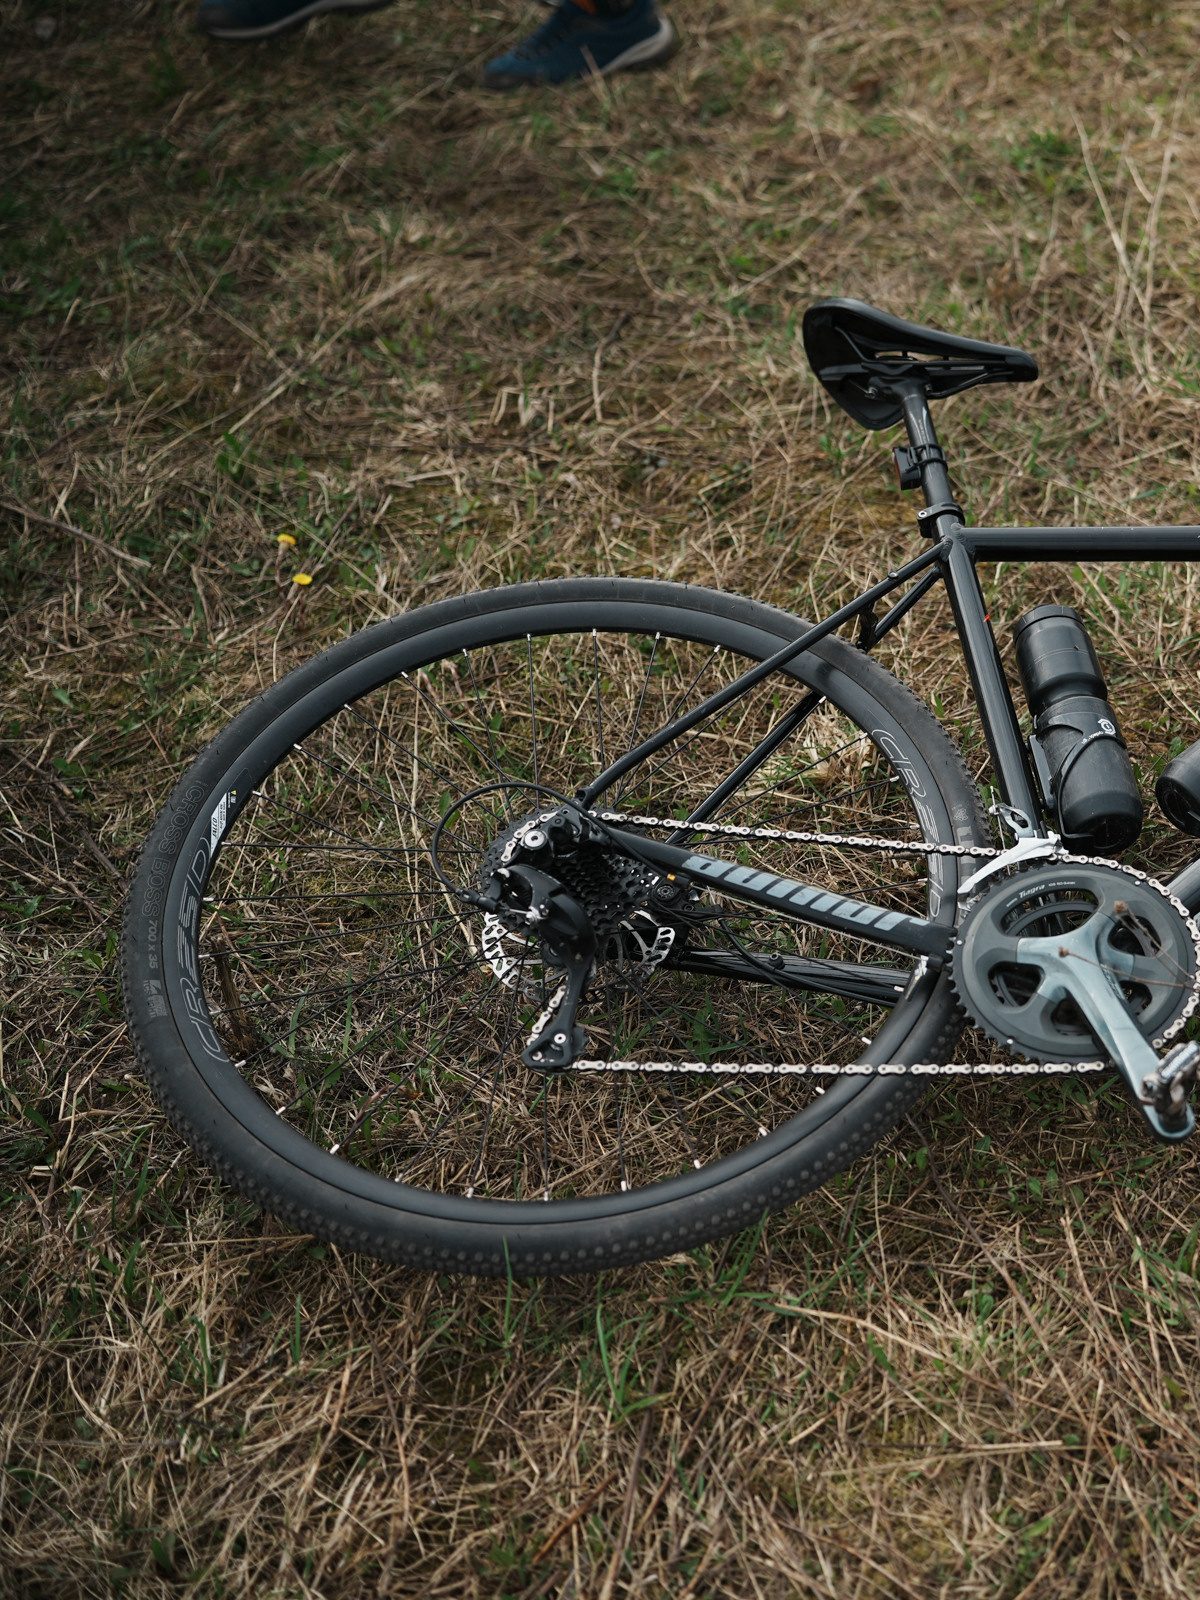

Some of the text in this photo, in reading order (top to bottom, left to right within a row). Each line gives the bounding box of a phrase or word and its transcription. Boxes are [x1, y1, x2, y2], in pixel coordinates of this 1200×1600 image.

[158, 785, 205, 855] CROSS
[144, 858, 170, 918] BOSS
[1019, 884, 1045, 898] Tiagra
[146, 920, 158, 942] 700
[147, 953, 160, 971] 35
